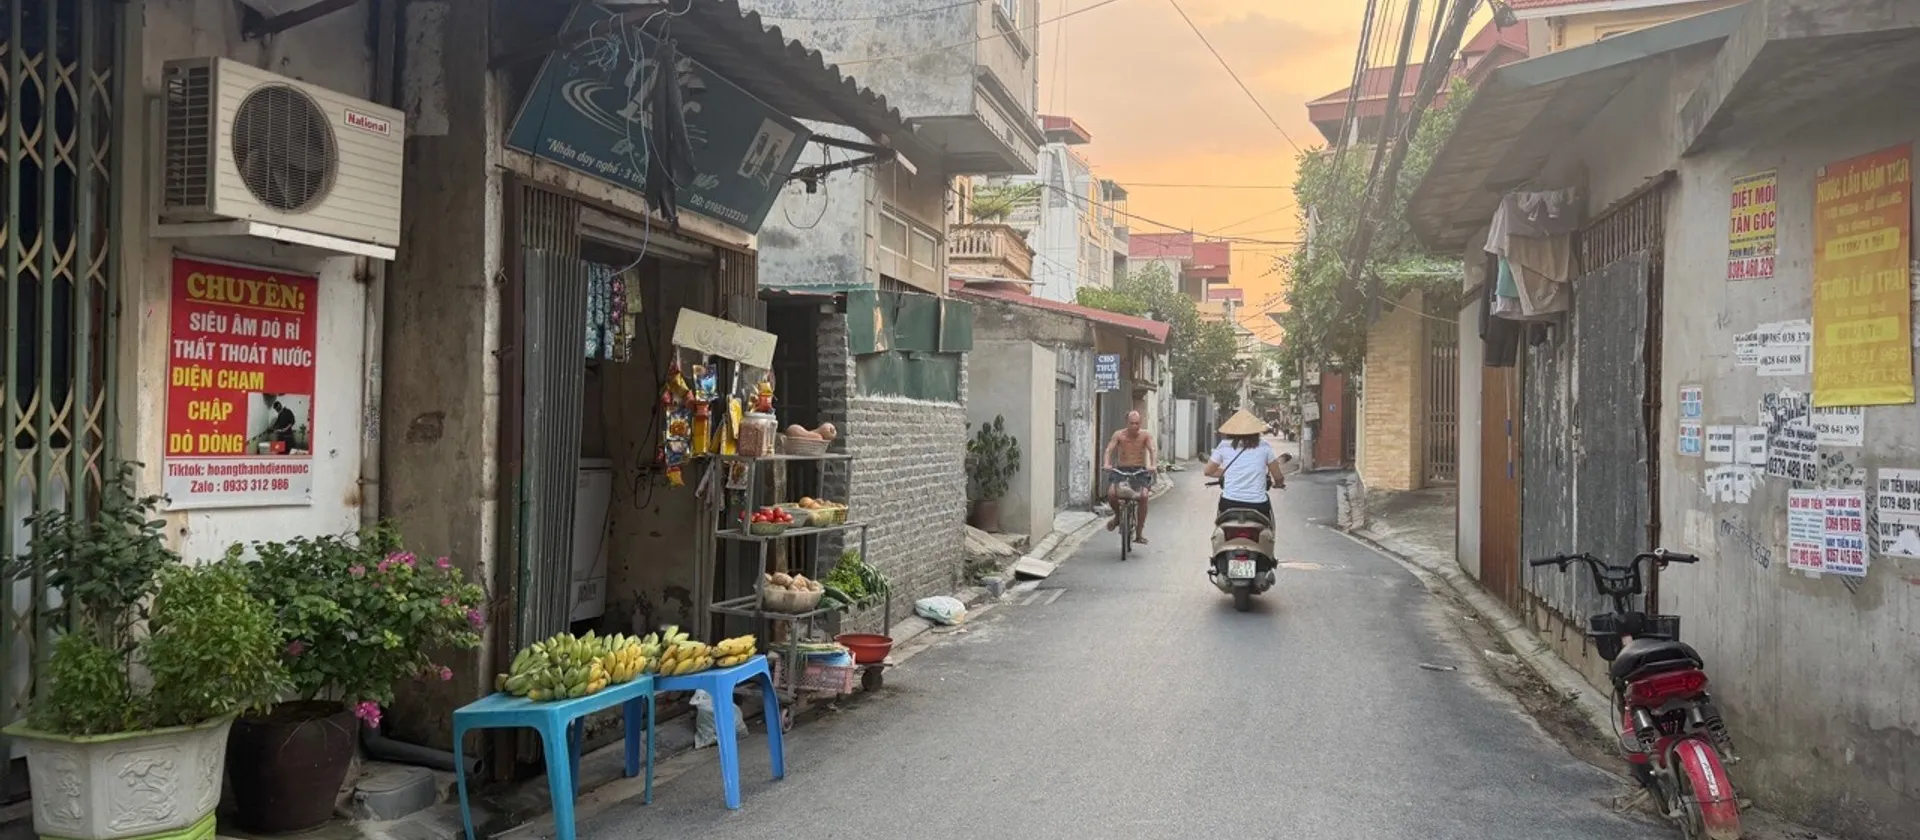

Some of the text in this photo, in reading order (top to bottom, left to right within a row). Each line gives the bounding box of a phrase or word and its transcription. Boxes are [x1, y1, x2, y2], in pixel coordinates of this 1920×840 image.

[347, 112, 387, 132] National
[623, 167, 632, 179] 3
[1732, 179, 1777, 211] DIỆT MỐI
[1731, 208, 1775, 237] TẬN GỐC
[187, 273, 305, 311] CHUYÊN:
[190, 310, 300, 341] SIÊU ÂM DÒ RỈ
[174, 335, 312, 367] THẤT THOÁT NƯỚC
[1098, 355, 1115, 363] CHO
[172, 364, 265, 394] ĐIỆN CHẠM
[187, 396, 233, 425] CHẬP
[170, 426, 243, 454] DÒ DÒNG
[168, 462, 309, 478] Tiktok: hoangthanhdiennuoc
[1768, 456, 1787, 476] 0379
[1787, 458, 1801, 479] 489
[1802, 462, 1817, 482] 163
[190, 479, 214, 493] Zalo
[223, 479, 249, 492] 0933
[250, 479, 270, 491] 312
[271, 479, 289, 491] 986
